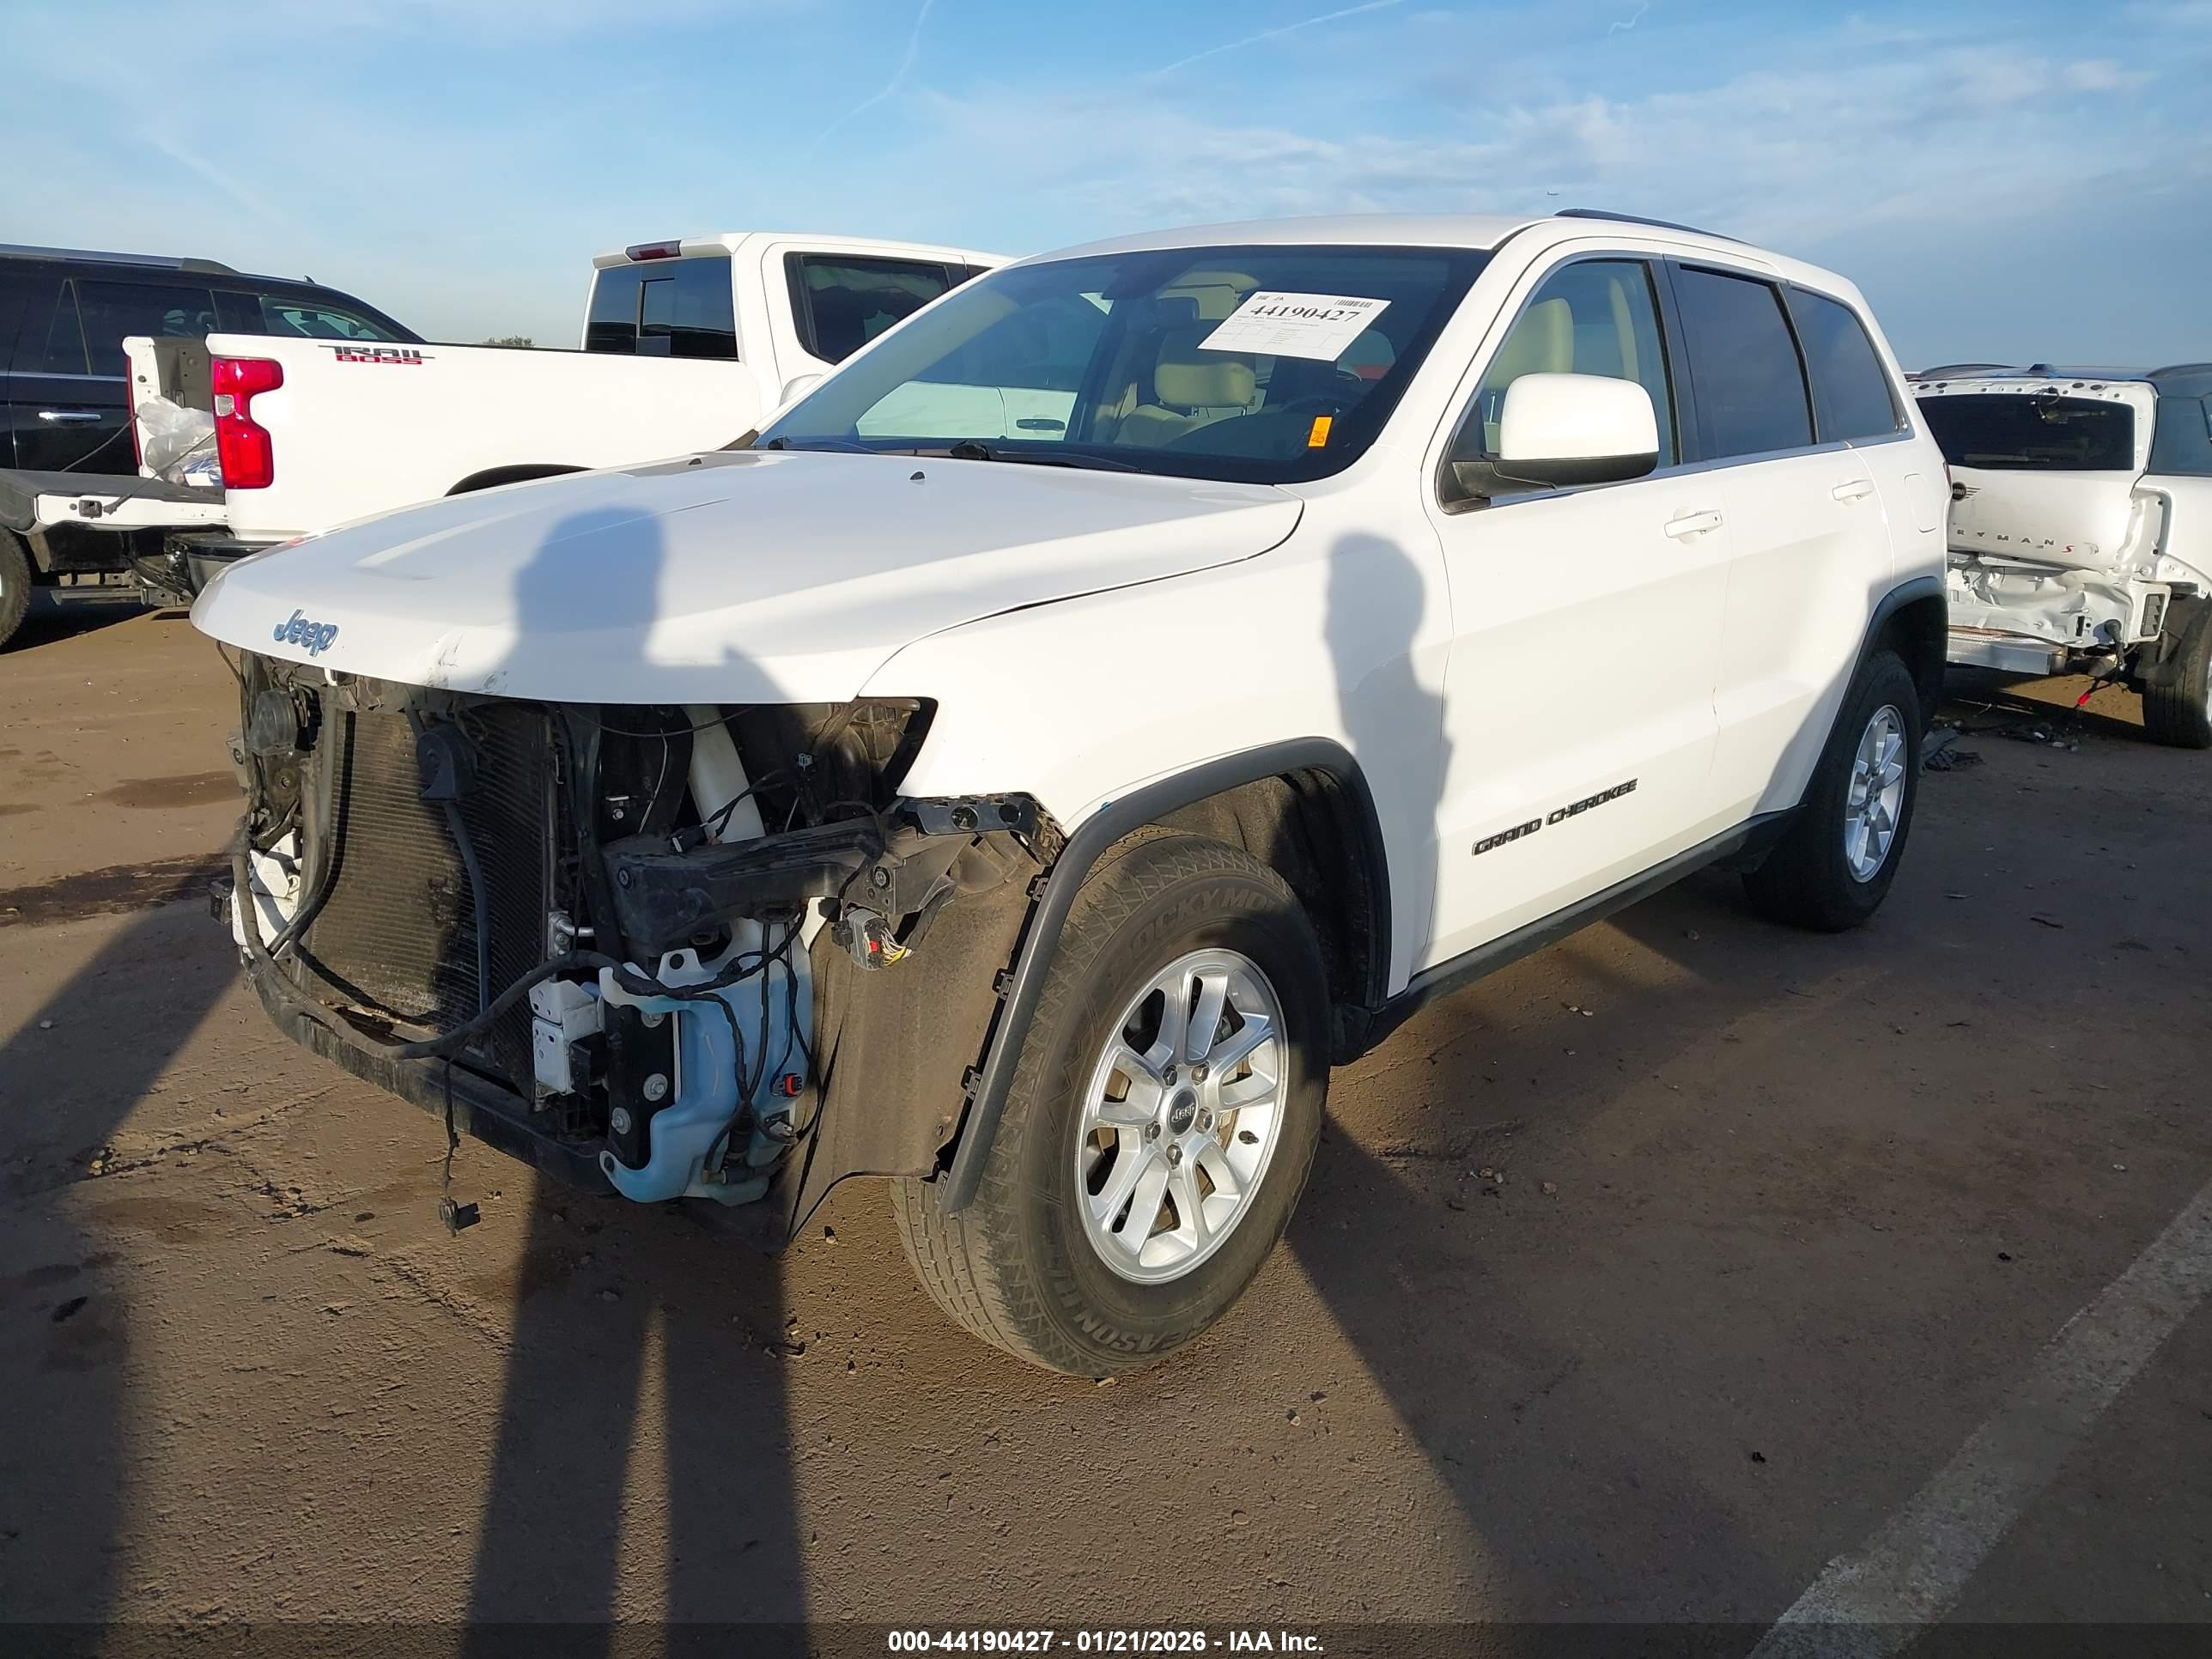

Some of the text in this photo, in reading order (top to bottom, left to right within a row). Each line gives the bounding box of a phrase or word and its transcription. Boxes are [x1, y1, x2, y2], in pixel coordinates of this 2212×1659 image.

[1249, 304, 1361, 323] 44190427
[318, 344, 435, 358] TRAIL
[335, 354, 422, 365] BOSS
[1956, 528, 2055, 546] RYMAN
[273, 608, 339, 658] Jeep
[1472, 778, 1638, 856] GRAND CHEROKEE
[1171, 1103, 1195, 1123] Jeep
